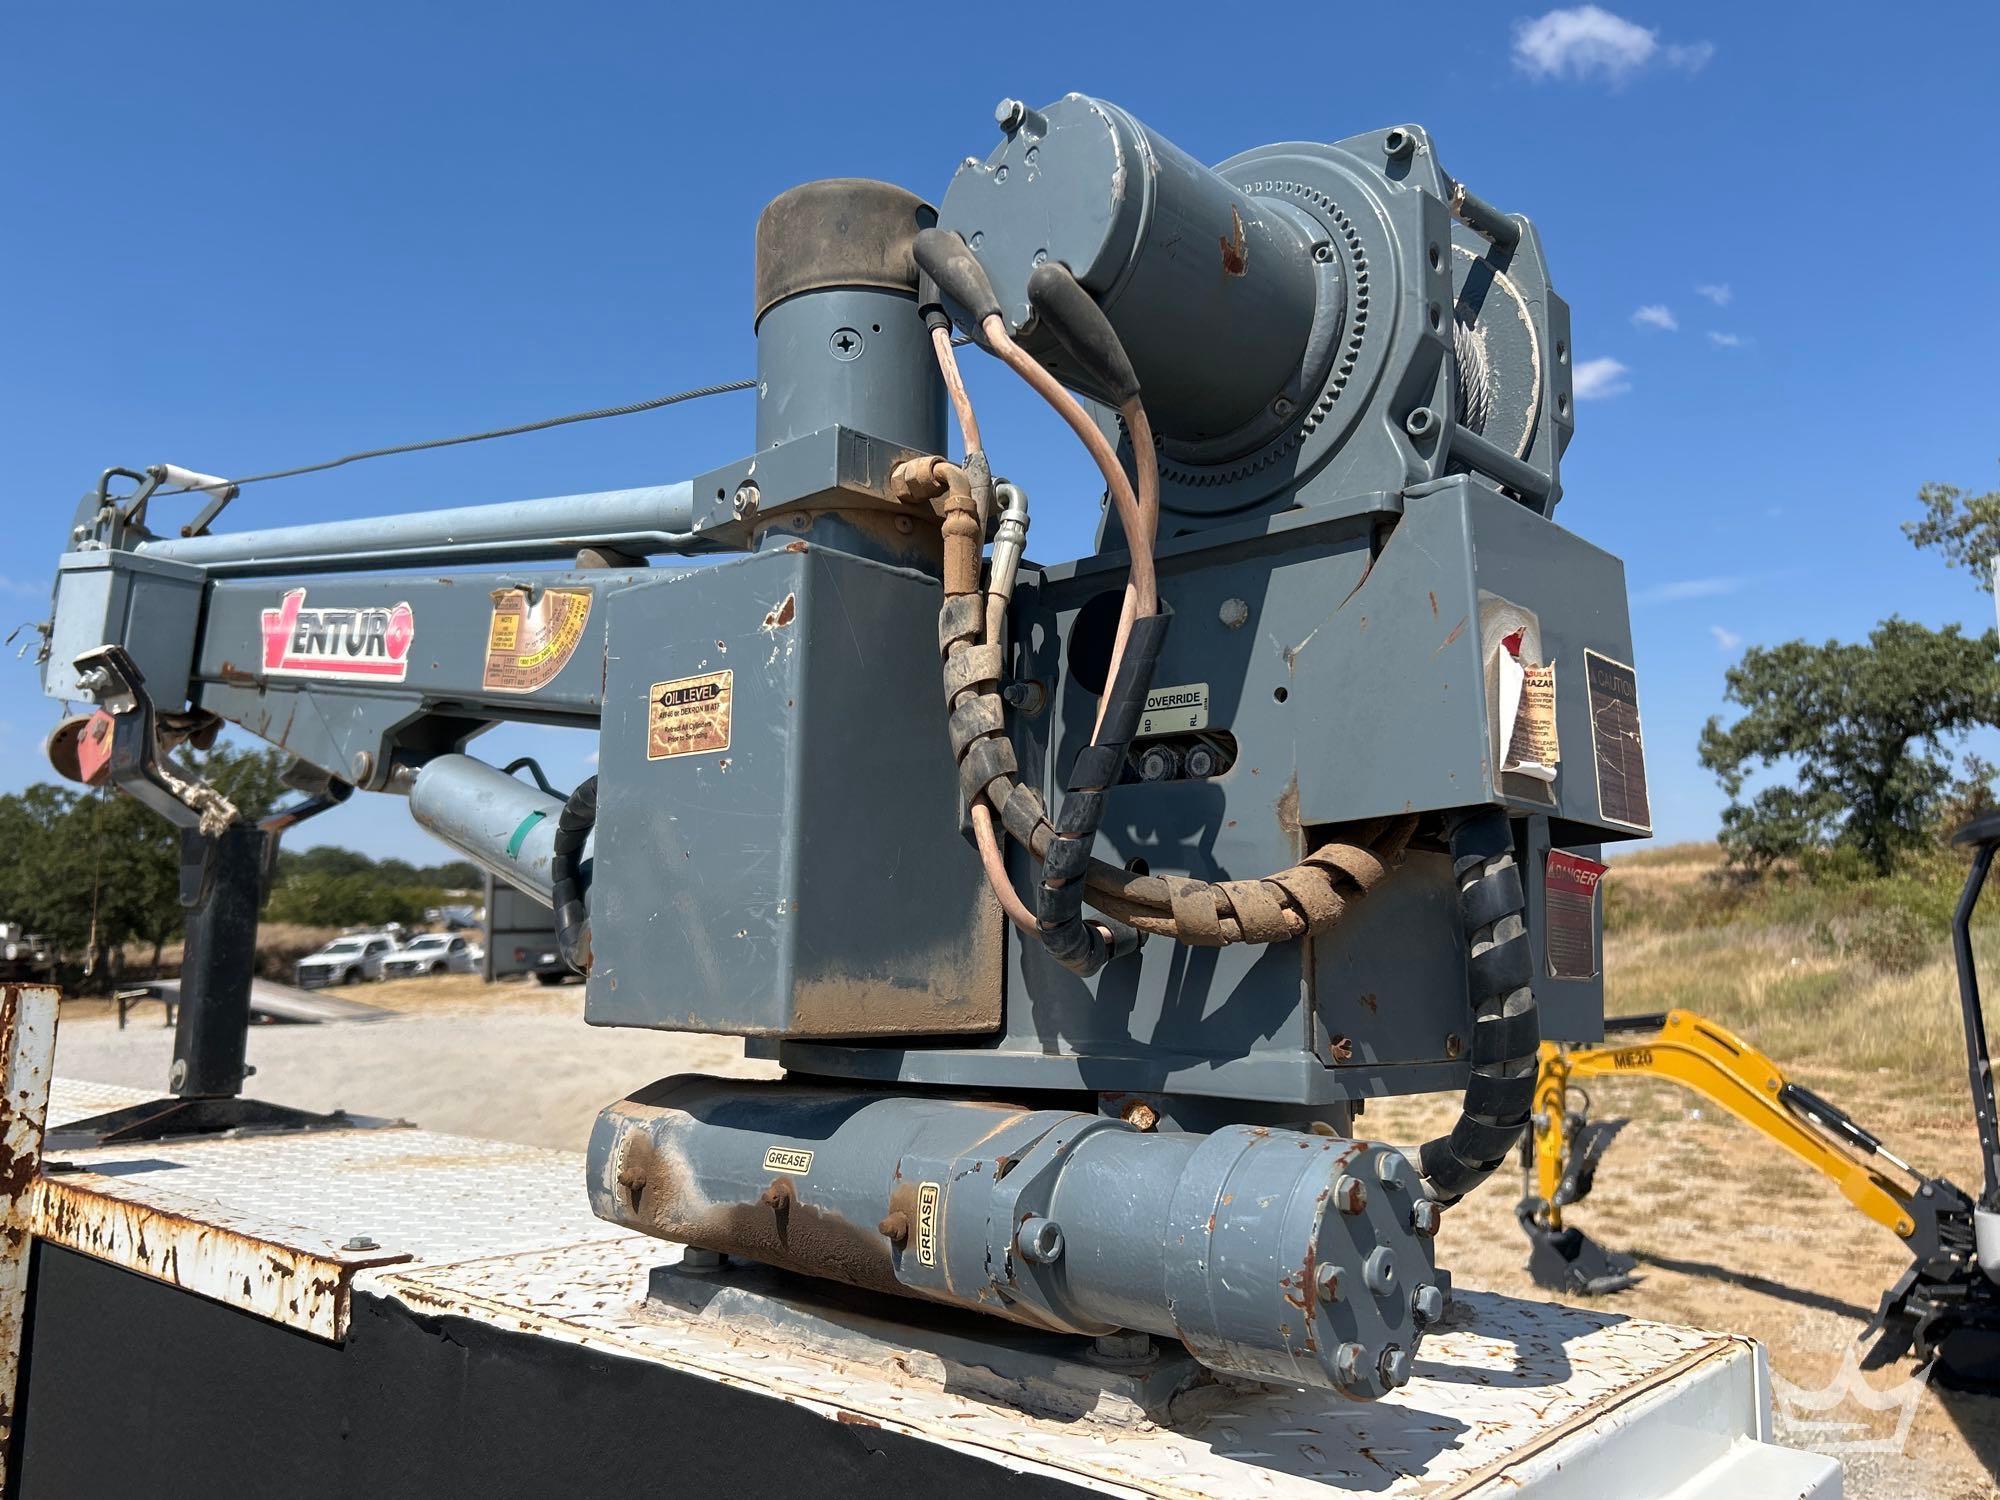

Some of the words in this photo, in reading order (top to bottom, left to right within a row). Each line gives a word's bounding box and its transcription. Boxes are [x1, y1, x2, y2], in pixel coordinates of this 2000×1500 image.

[263, 588, 413, 668] VENTURO
[1598, 670, 1635, 698] CAUTION
[664, 692, 681, 706] OIL
[684, 686, 716, 703] LEVEL
[1148, 692, 1200, 708] OVERRIDE
[1145, 719, 1151, 732] BD
[1190, 714, 1198, 726] RL
[1555, 864, 1598, 886] DANGER
[1613, 1050, 1653, 1069] ME20
[768, 1152, 806, 1168] GREASE
[922, 1193, 934, 1261] GREASE
